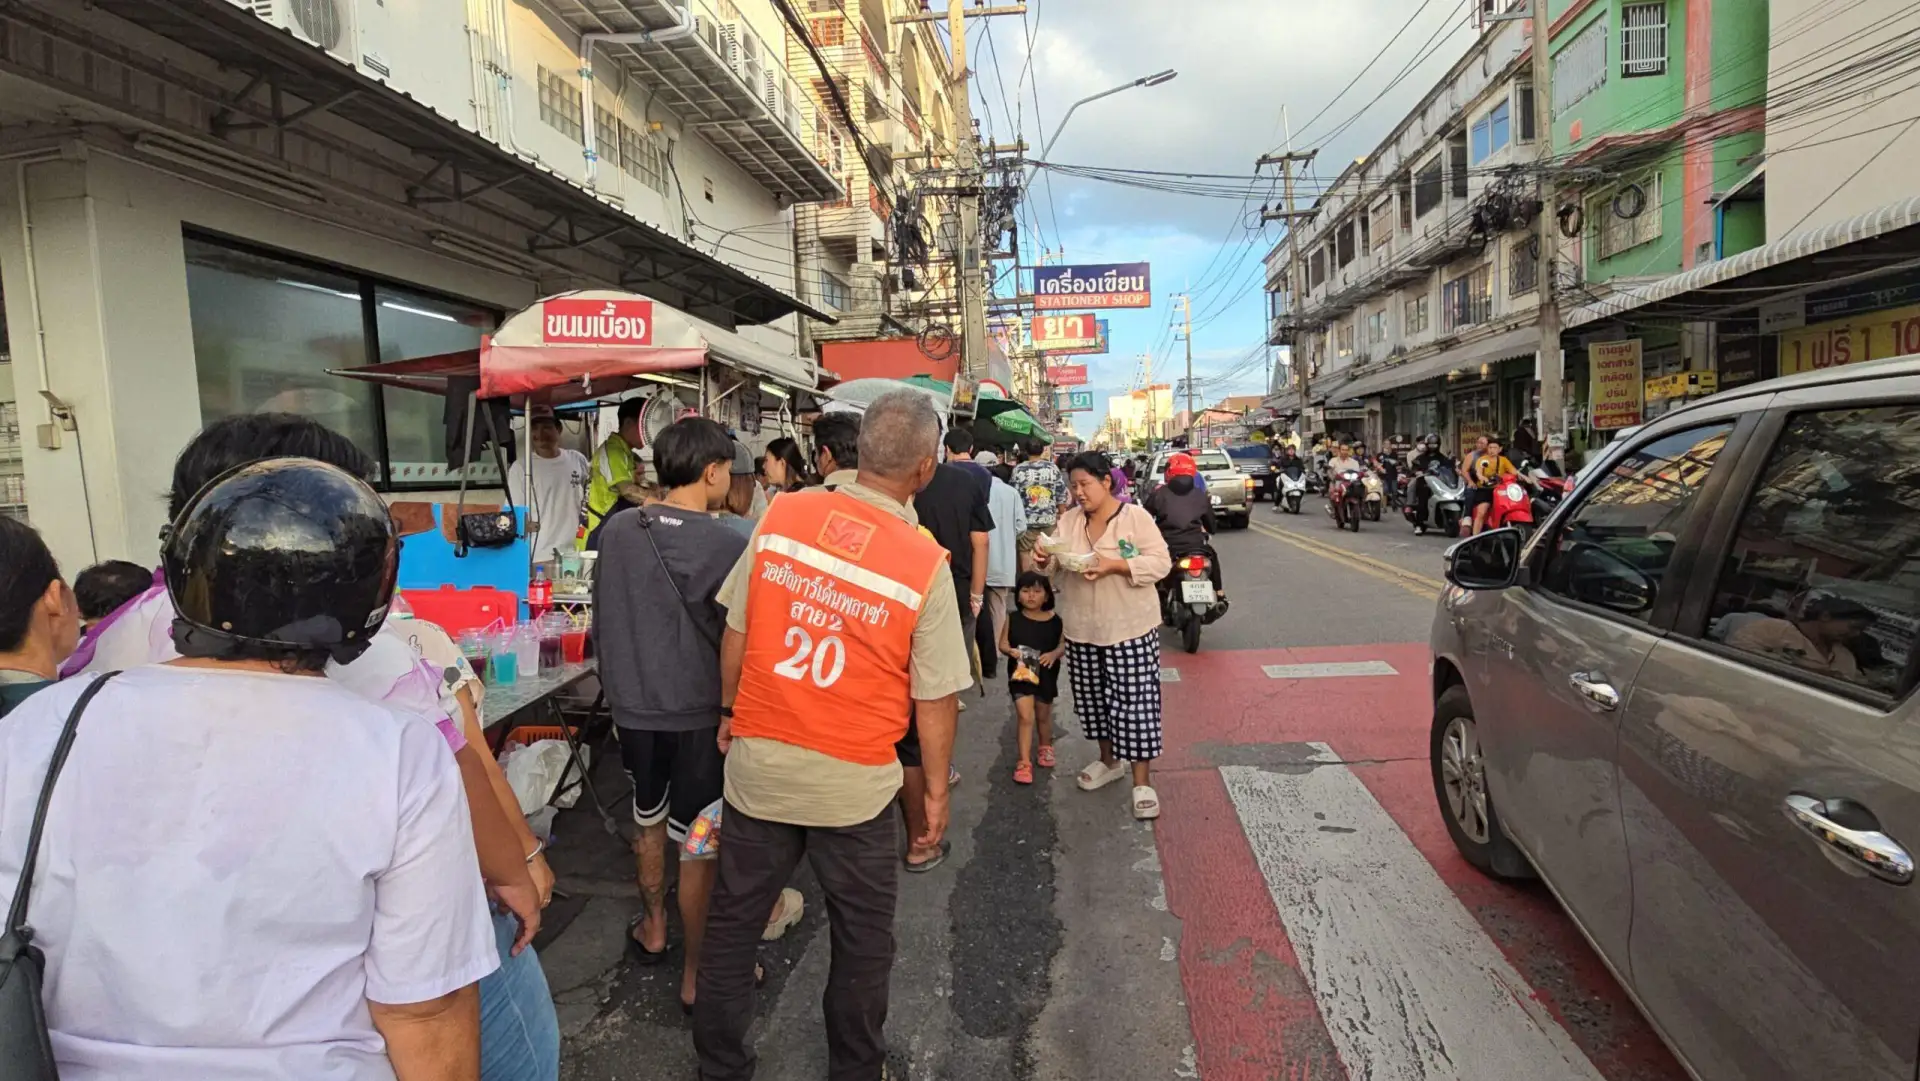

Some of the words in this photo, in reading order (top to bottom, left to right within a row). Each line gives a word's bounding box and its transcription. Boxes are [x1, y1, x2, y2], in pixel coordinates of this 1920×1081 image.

[1040, 268, 1144, 293] เครื่องเขียน
[1040, 295, 1109, 307] STATIONERY
[1112, 294, 1144, 306] SHOP
[547, 301, 646, 340] ขนมเบื้อง
[1043, 316, 1084, 339] ยา
[1811, 323, 1851, 369] ฟรี
[1596, 358, 1635, 370] เอกสาร
[1073, 393, 1090, 406] ยา
[1595, 399, 1638, 412] กรอบรูป
[761, 560, 890, 628] รอยัลการ์เด้นพลาซ่า
[790, 601, 826, 627] สาย
[828, 614, 844, 631] 2
[773, 626, 846, 688] 20
